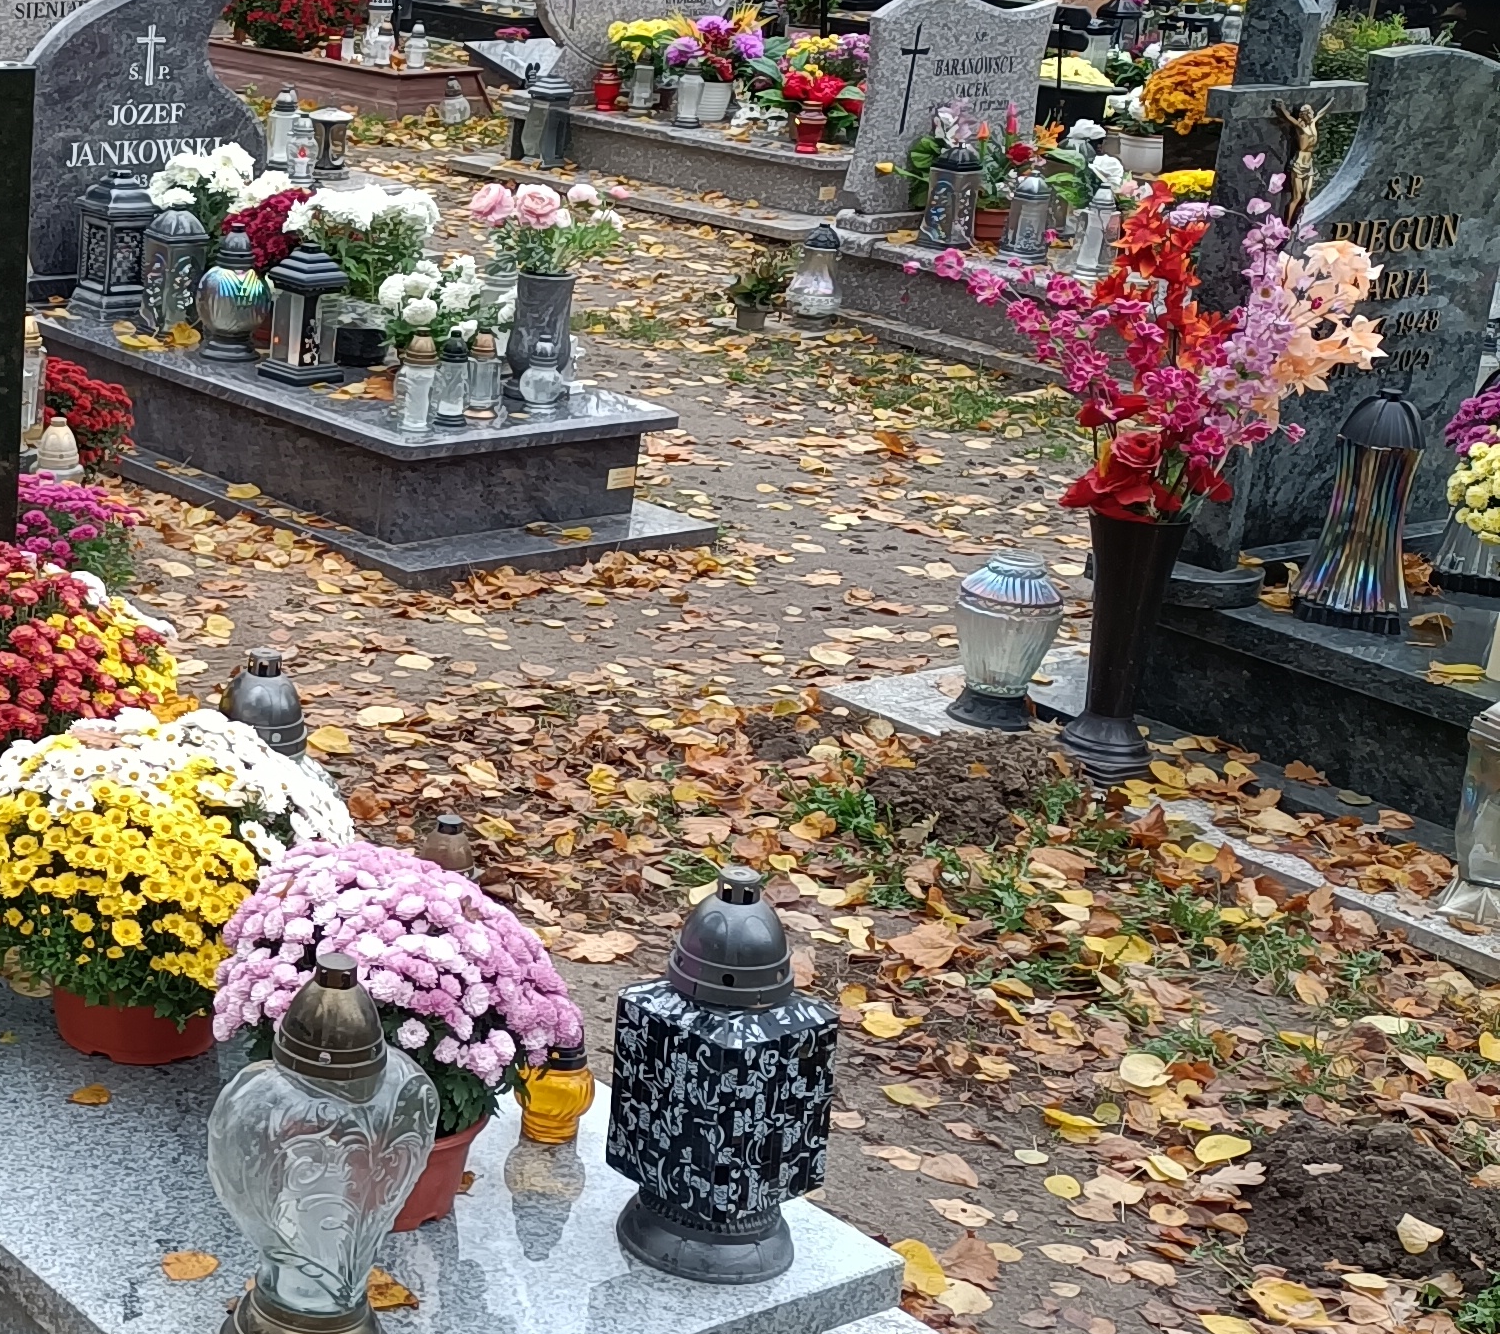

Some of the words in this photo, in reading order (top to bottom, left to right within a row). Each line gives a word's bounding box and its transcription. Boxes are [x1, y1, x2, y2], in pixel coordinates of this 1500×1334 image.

[128, 62, 143, 80] Ś.
[157, 65, 170, 80] P.
[933, 55, 1018, 77] BARANOWSCY
[956, 82, 990, 97] JACEK
[107, 99, 187, 126] JÓZEF
[1367, 269, 1430, 301] ARIA
